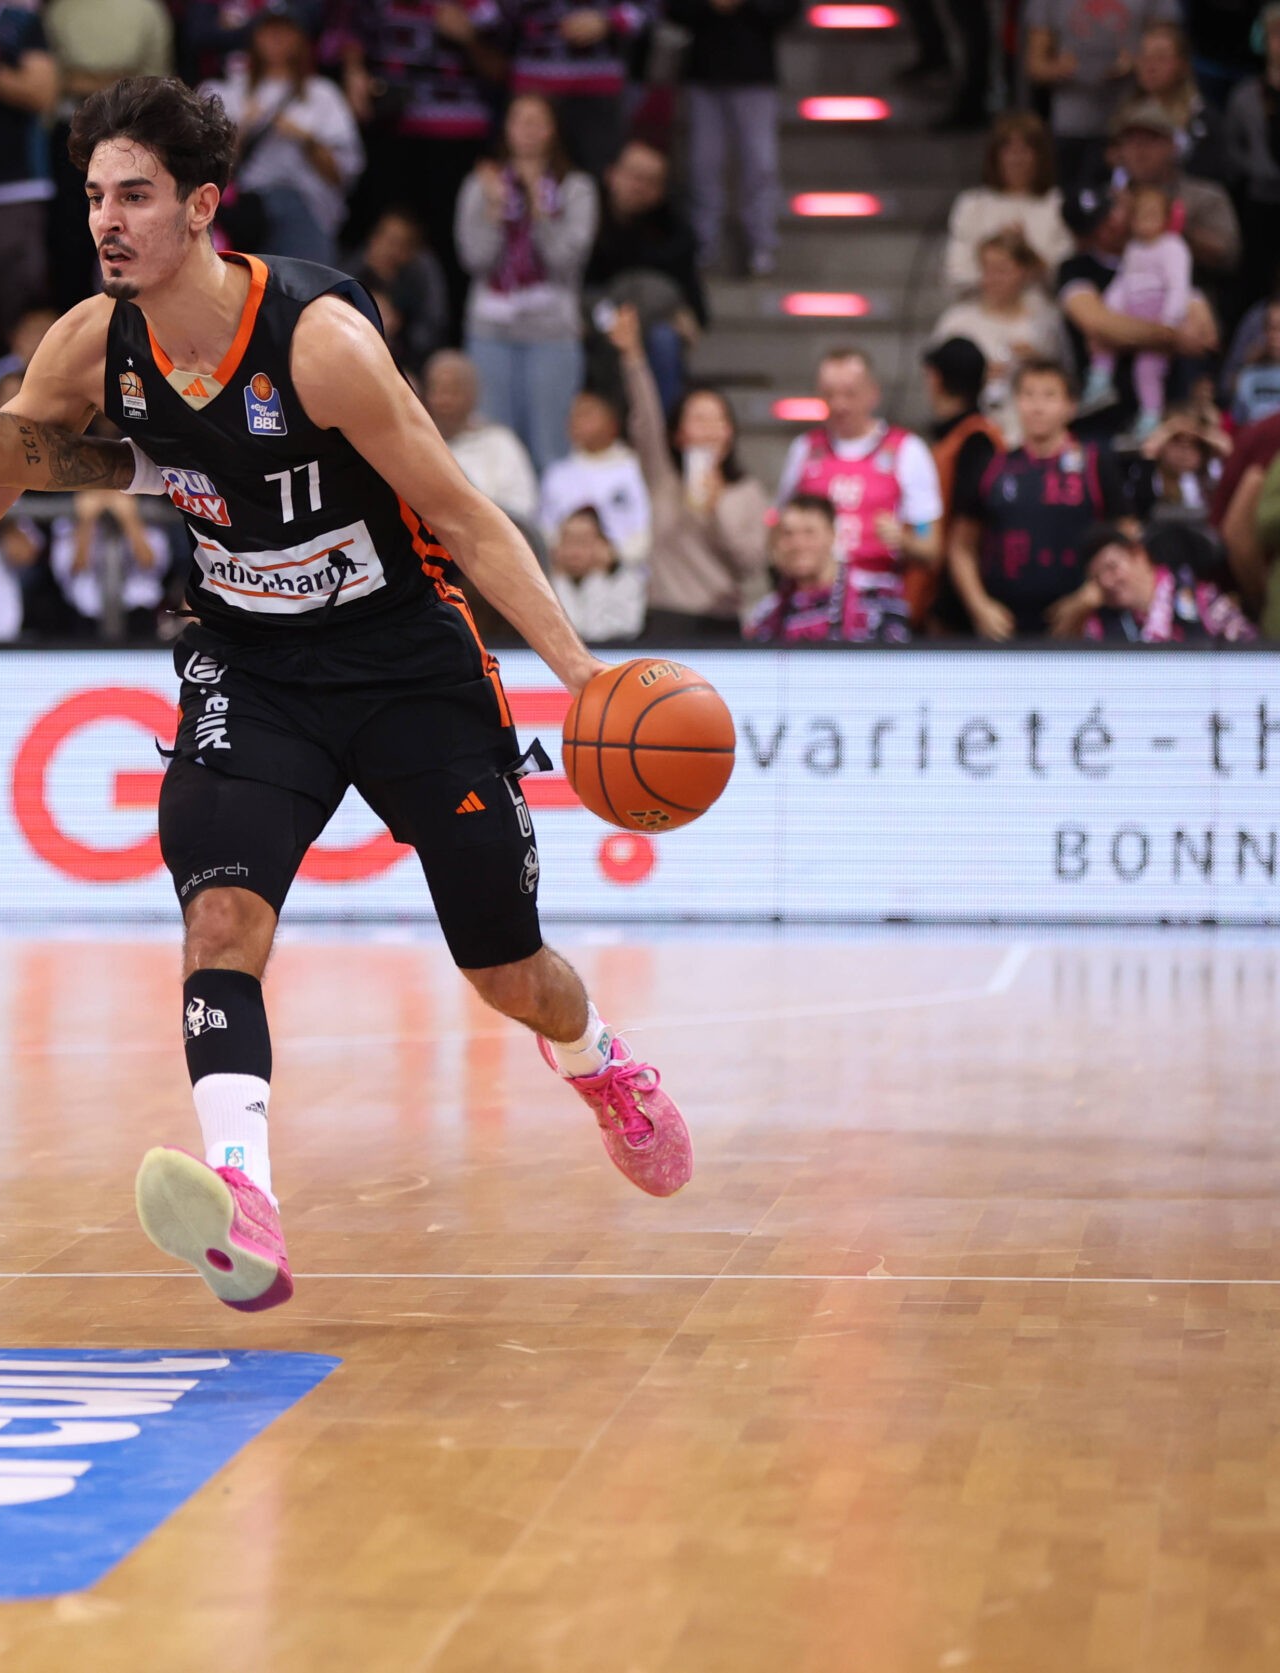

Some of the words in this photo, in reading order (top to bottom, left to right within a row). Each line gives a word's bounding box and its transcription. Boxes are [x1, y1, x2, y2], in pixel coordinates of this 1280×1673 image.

[253, 416, 282, 430] BBL
[160, 469, 215, 496] QUI
[264, 459, 322, 524] 77
[1055, 824, 1279, 882] BONN
[180, 862, 249, 897] entorch
